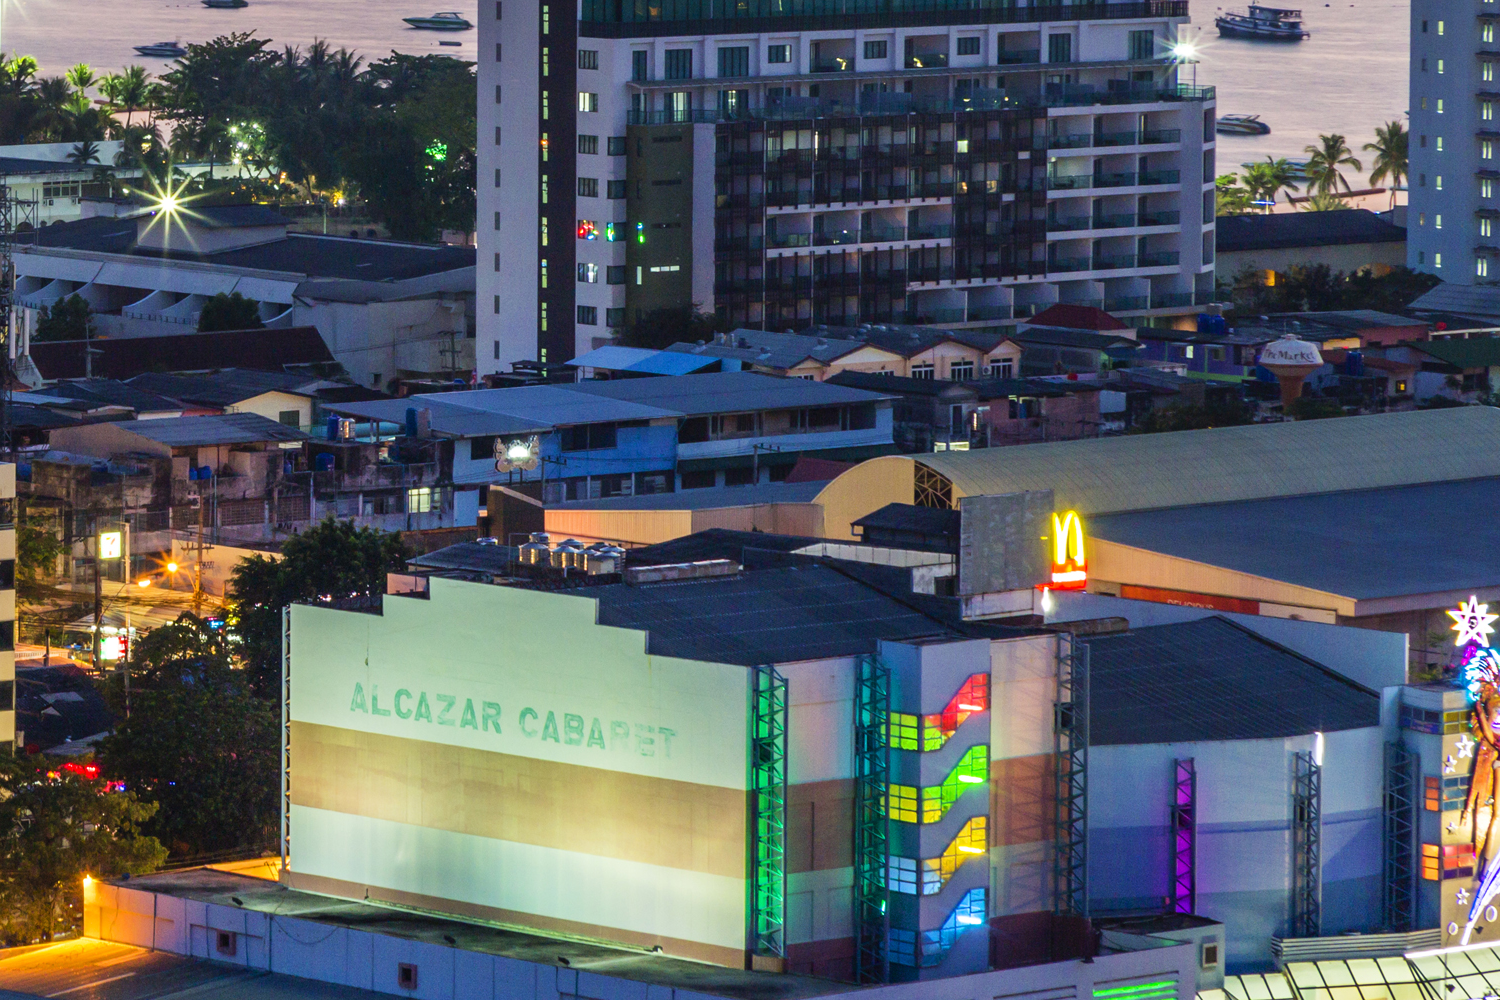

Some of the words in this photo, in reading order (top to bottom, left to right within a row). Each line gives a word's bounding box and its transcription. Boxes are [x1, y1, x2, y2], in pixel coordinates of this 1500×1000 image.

[1278, 350, 1316, 362] Market
[349, 681, 503, 735] ALCAZAR
[518, 707, 677, 758] CABARET
